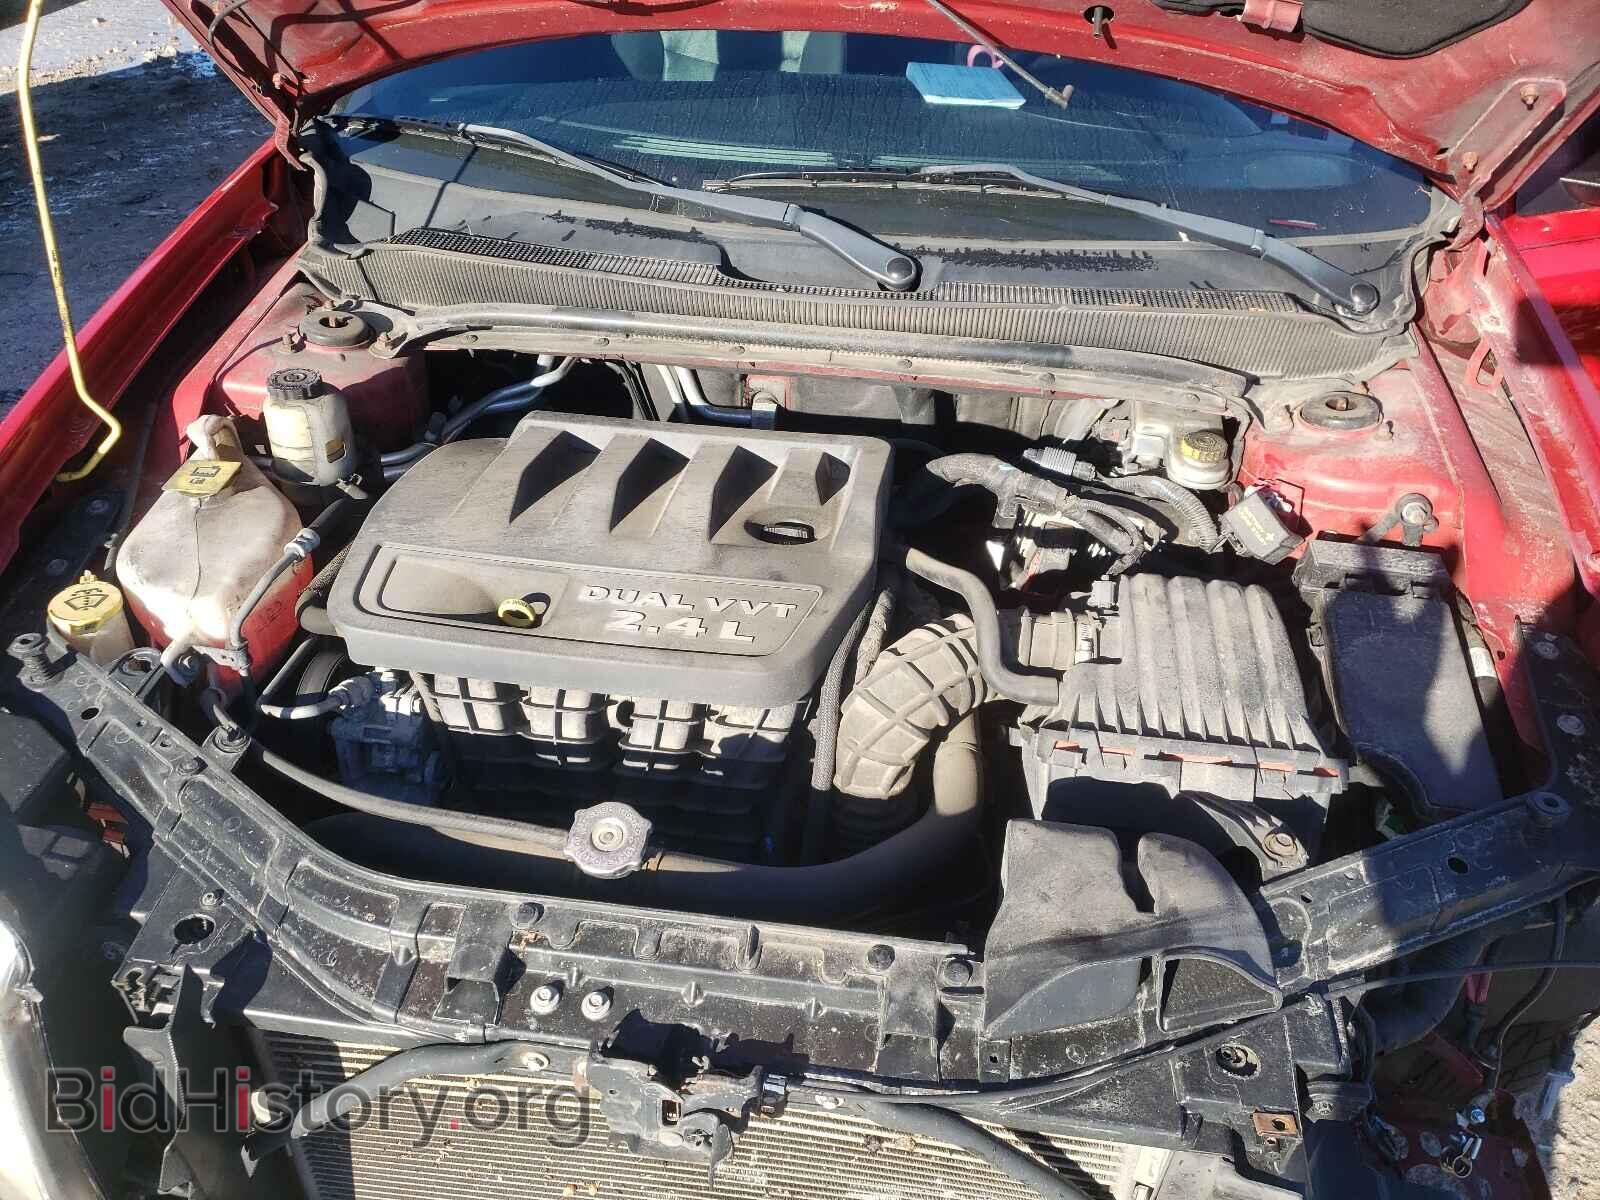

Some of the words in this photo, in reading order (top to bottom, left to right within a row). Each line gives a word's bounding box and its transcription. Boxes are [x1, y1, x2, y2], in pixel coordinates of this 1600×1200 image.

[579, 585, 695, 611] DUAL
[706, 596, 798, 618] VVT
[606, 609, 708, 637] 2.4
[719, 620, 755, 642] L
